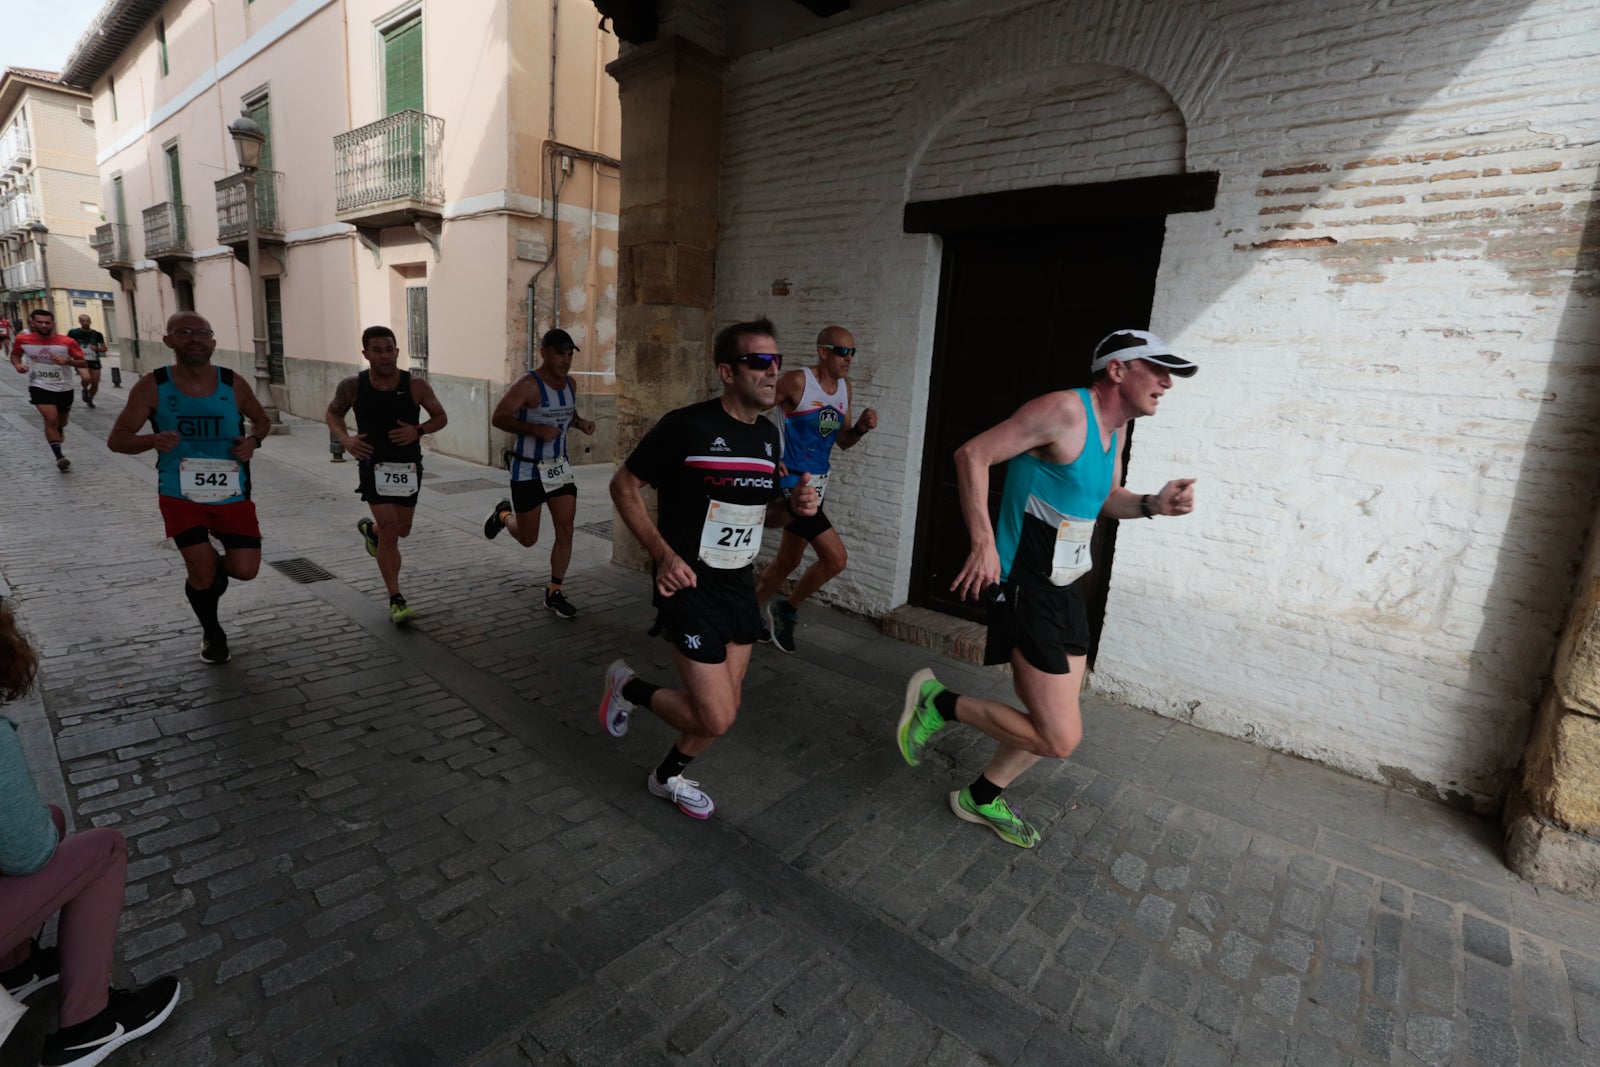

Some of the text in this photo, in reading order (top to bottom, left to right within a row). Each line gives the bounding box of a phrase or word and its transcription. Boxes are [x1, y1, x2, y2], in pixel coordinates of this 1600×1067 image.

[548, 465, 564, 478] 867
[195, 473, 228, 486] 542
[384, 473, 408, 484] 758
[717, 527, 753, 547] 274
